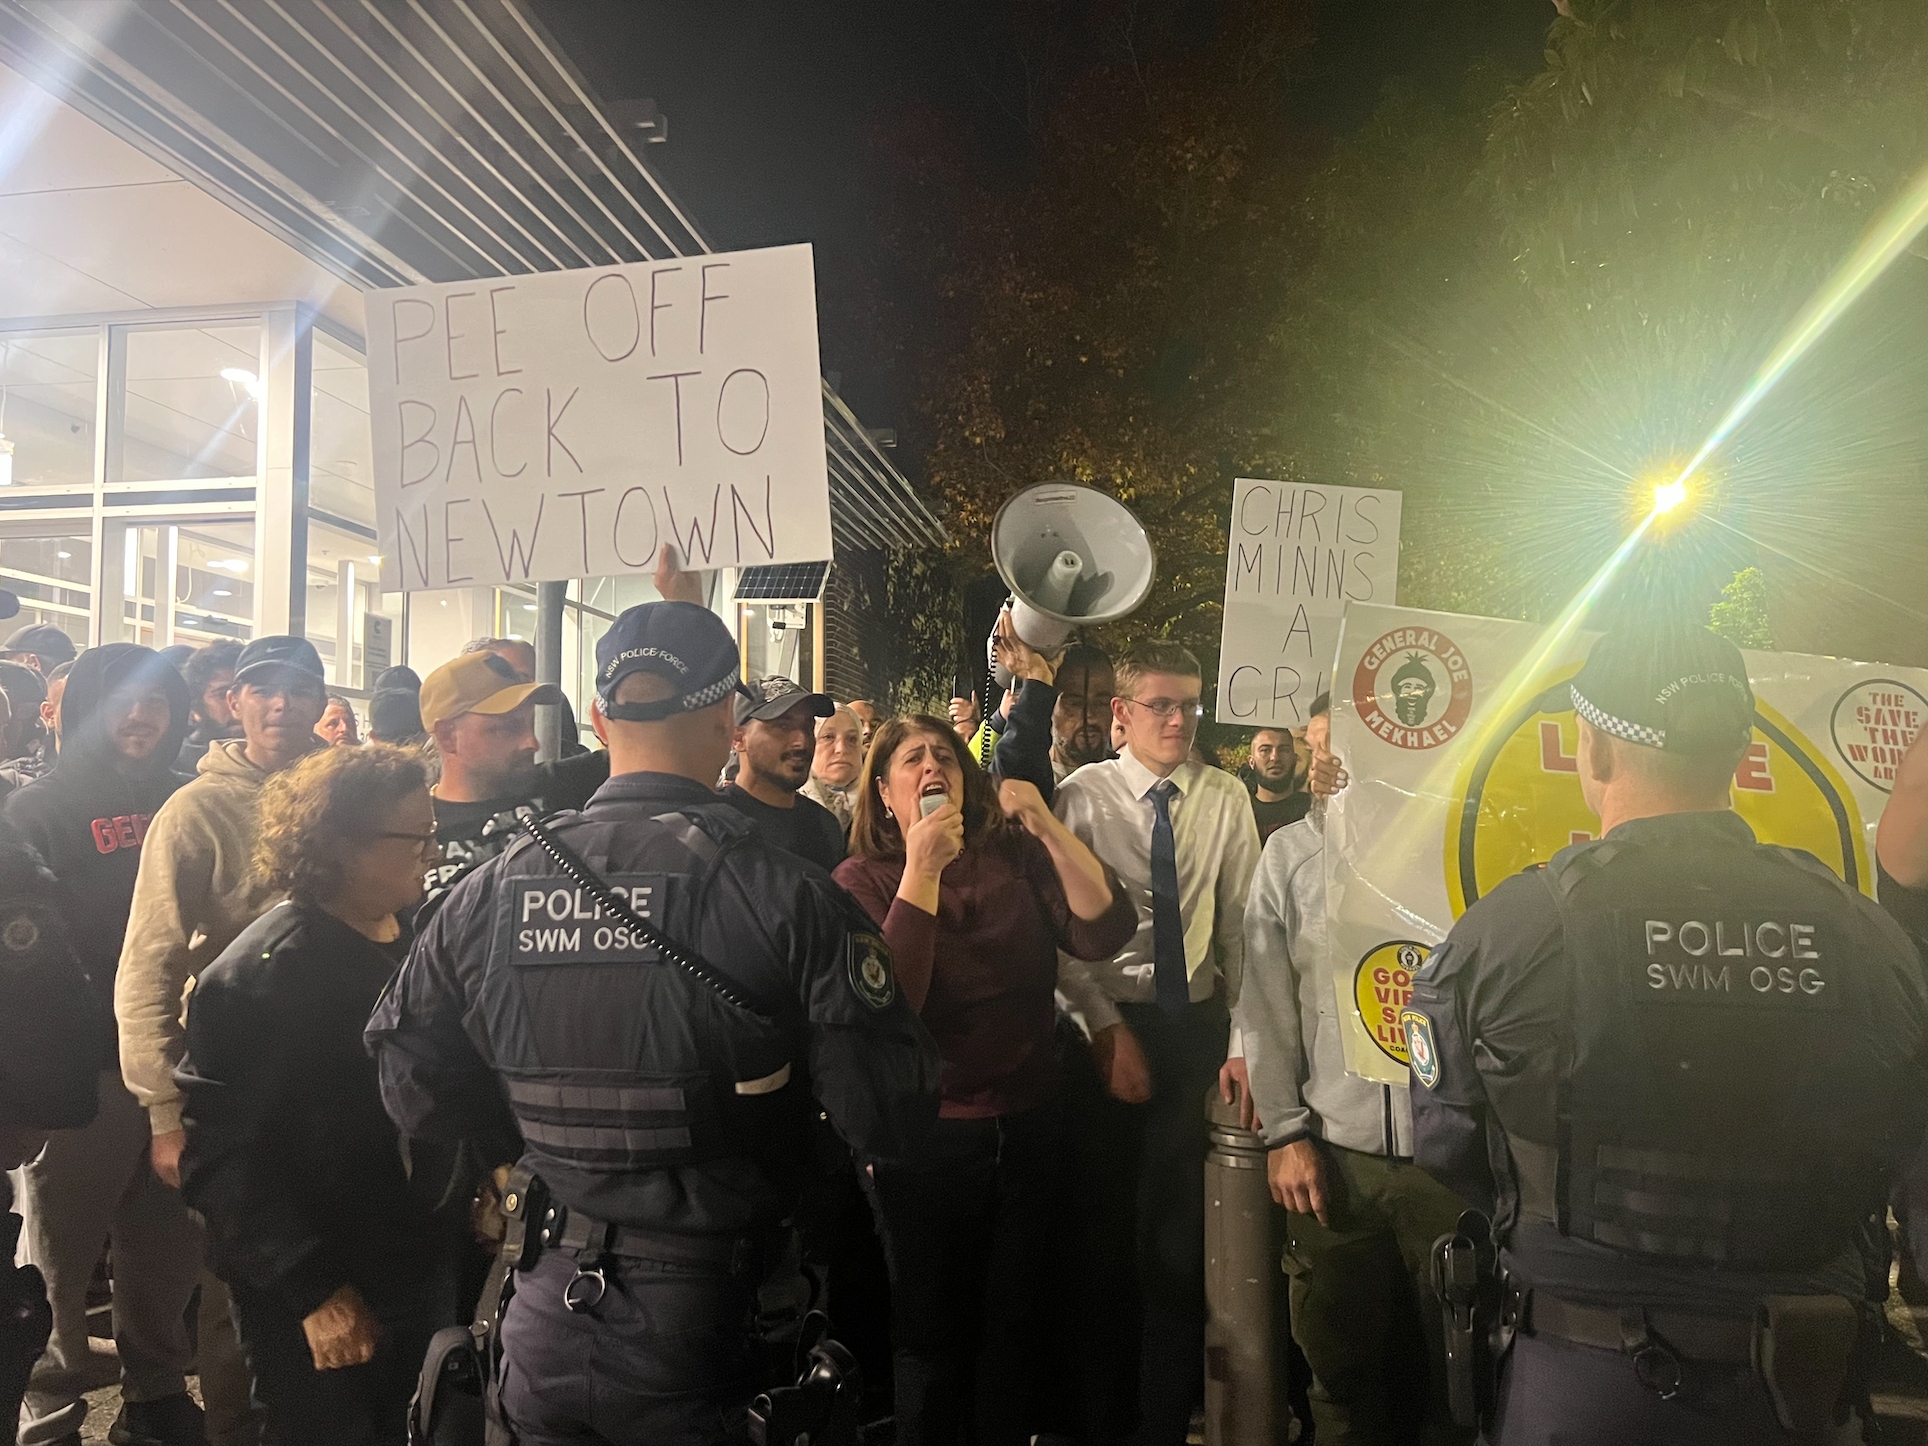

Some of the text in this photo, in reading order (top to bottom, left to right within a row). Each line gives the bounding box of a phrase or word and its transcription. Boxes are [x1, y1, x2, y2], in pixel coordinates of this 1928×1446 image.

[393, 264, 730, 384] PEE OFF
[399, 369, 770, 488] BACK TO
[1241, 486, 1380, 544] CHRIS
[396, 475, 774, 589] NEWTOWN
[1235, 542, 1374, 601] MINNS
[1281, 603, 1313, 657] A
[605, 647, 690, 679] NSW POLICE FORCE
[1364, 629, 1469, 682] GENERAL JOE
[1655, 681, 1680, 704] NSW
[1680, 672, 1726, 687] POLICE
[1869, 692, 1904, 707] THE
[1365, 710, 1457, 748] MEKHAEL
[1857, 706, 1919, 729] SAVE
[1864, 726, 1915, 747] THE
[1873, 766, 1898, 780] AR
[519, 927, 580, 952] SWM
[1646, 920, 1822, 959] POLICE
[1374, 967, 1411, 987] GO
[1647, 963, 1825, 995] SWM OSG
[1390, 1045, 1408, 1054] COA
